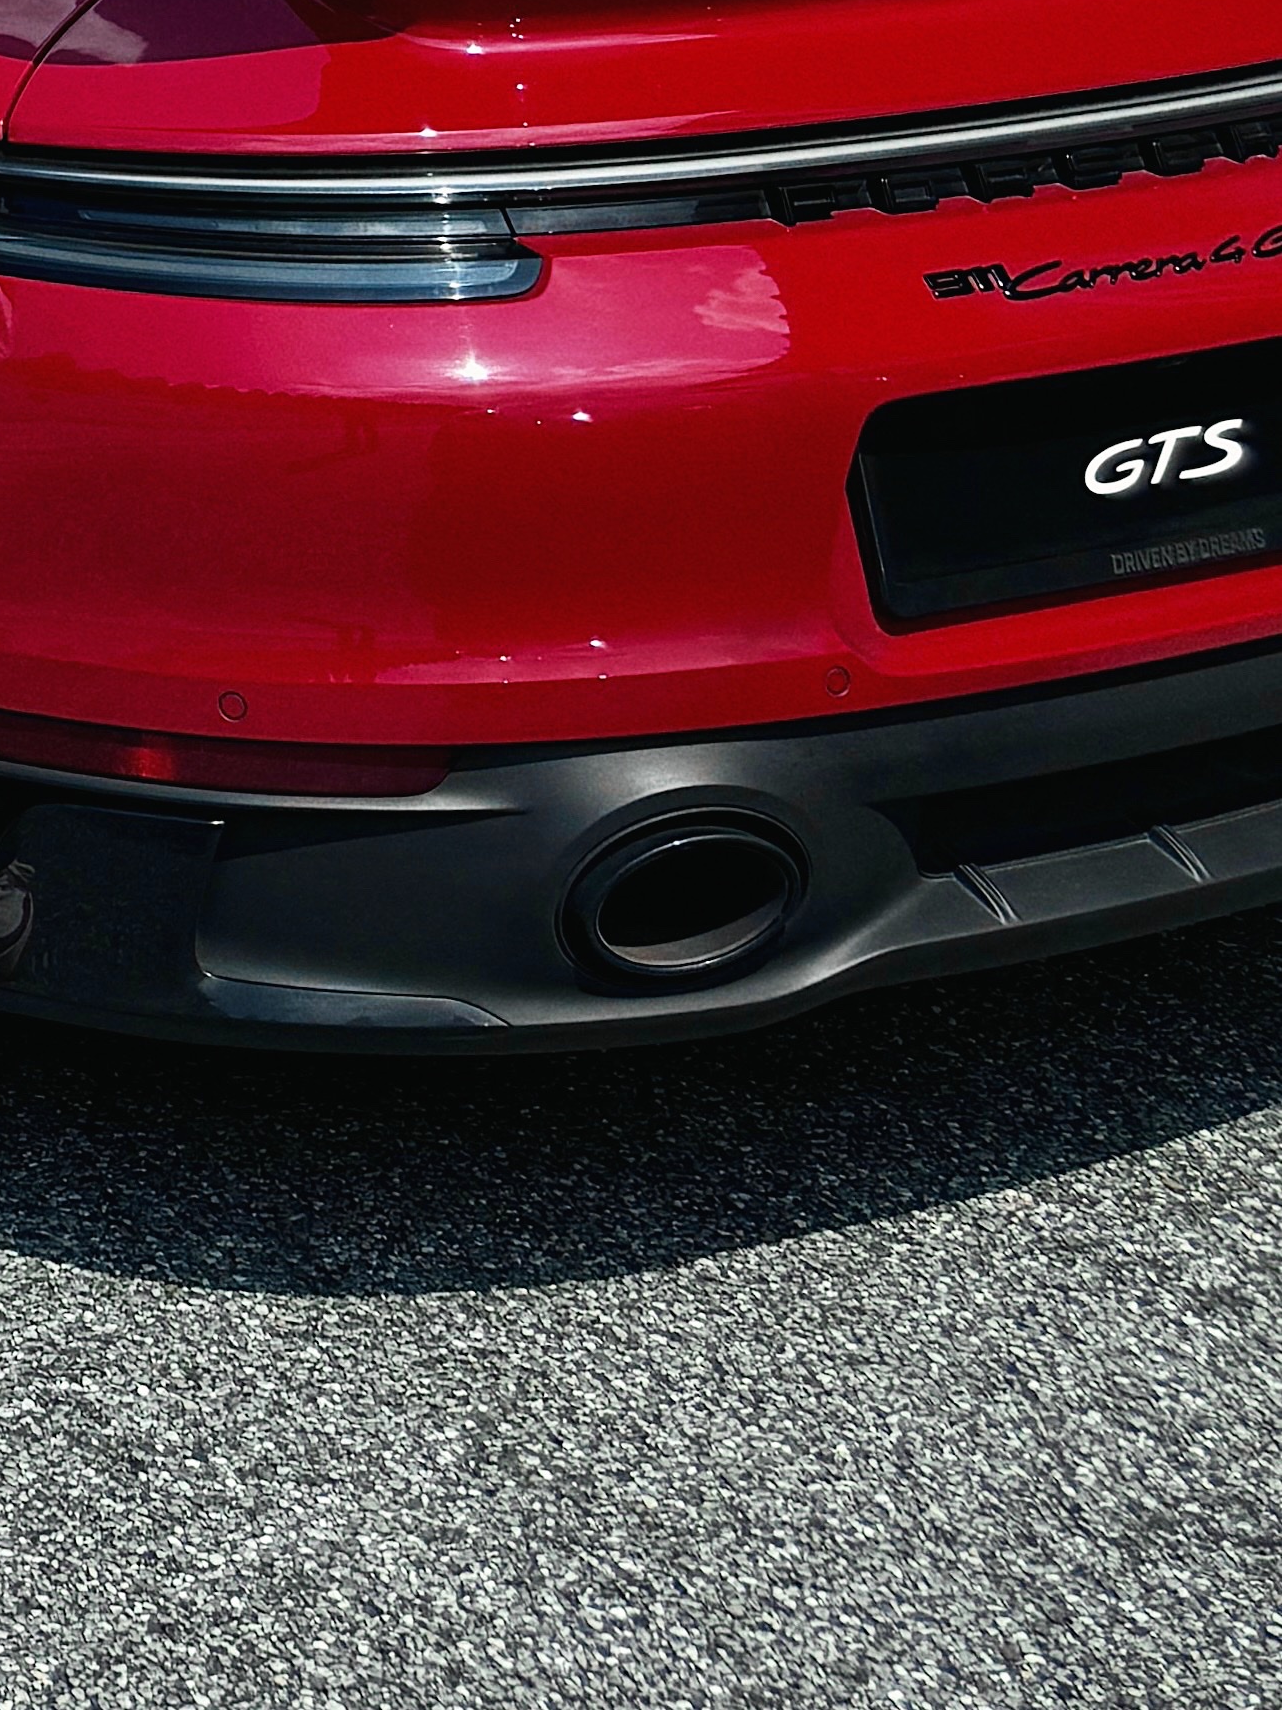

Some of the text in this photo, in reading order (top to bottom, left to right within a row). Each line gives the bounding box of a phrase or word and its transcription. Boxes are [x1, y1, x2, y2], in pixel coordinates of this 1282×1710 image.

[1003, 251, 1208, 301] Carrera
[1209, 235, 1246, 263] 4
[1085, 418, 1244, 495] GTS
[1110, 527, 1267, 575] DRIVEN BY DREAMS
